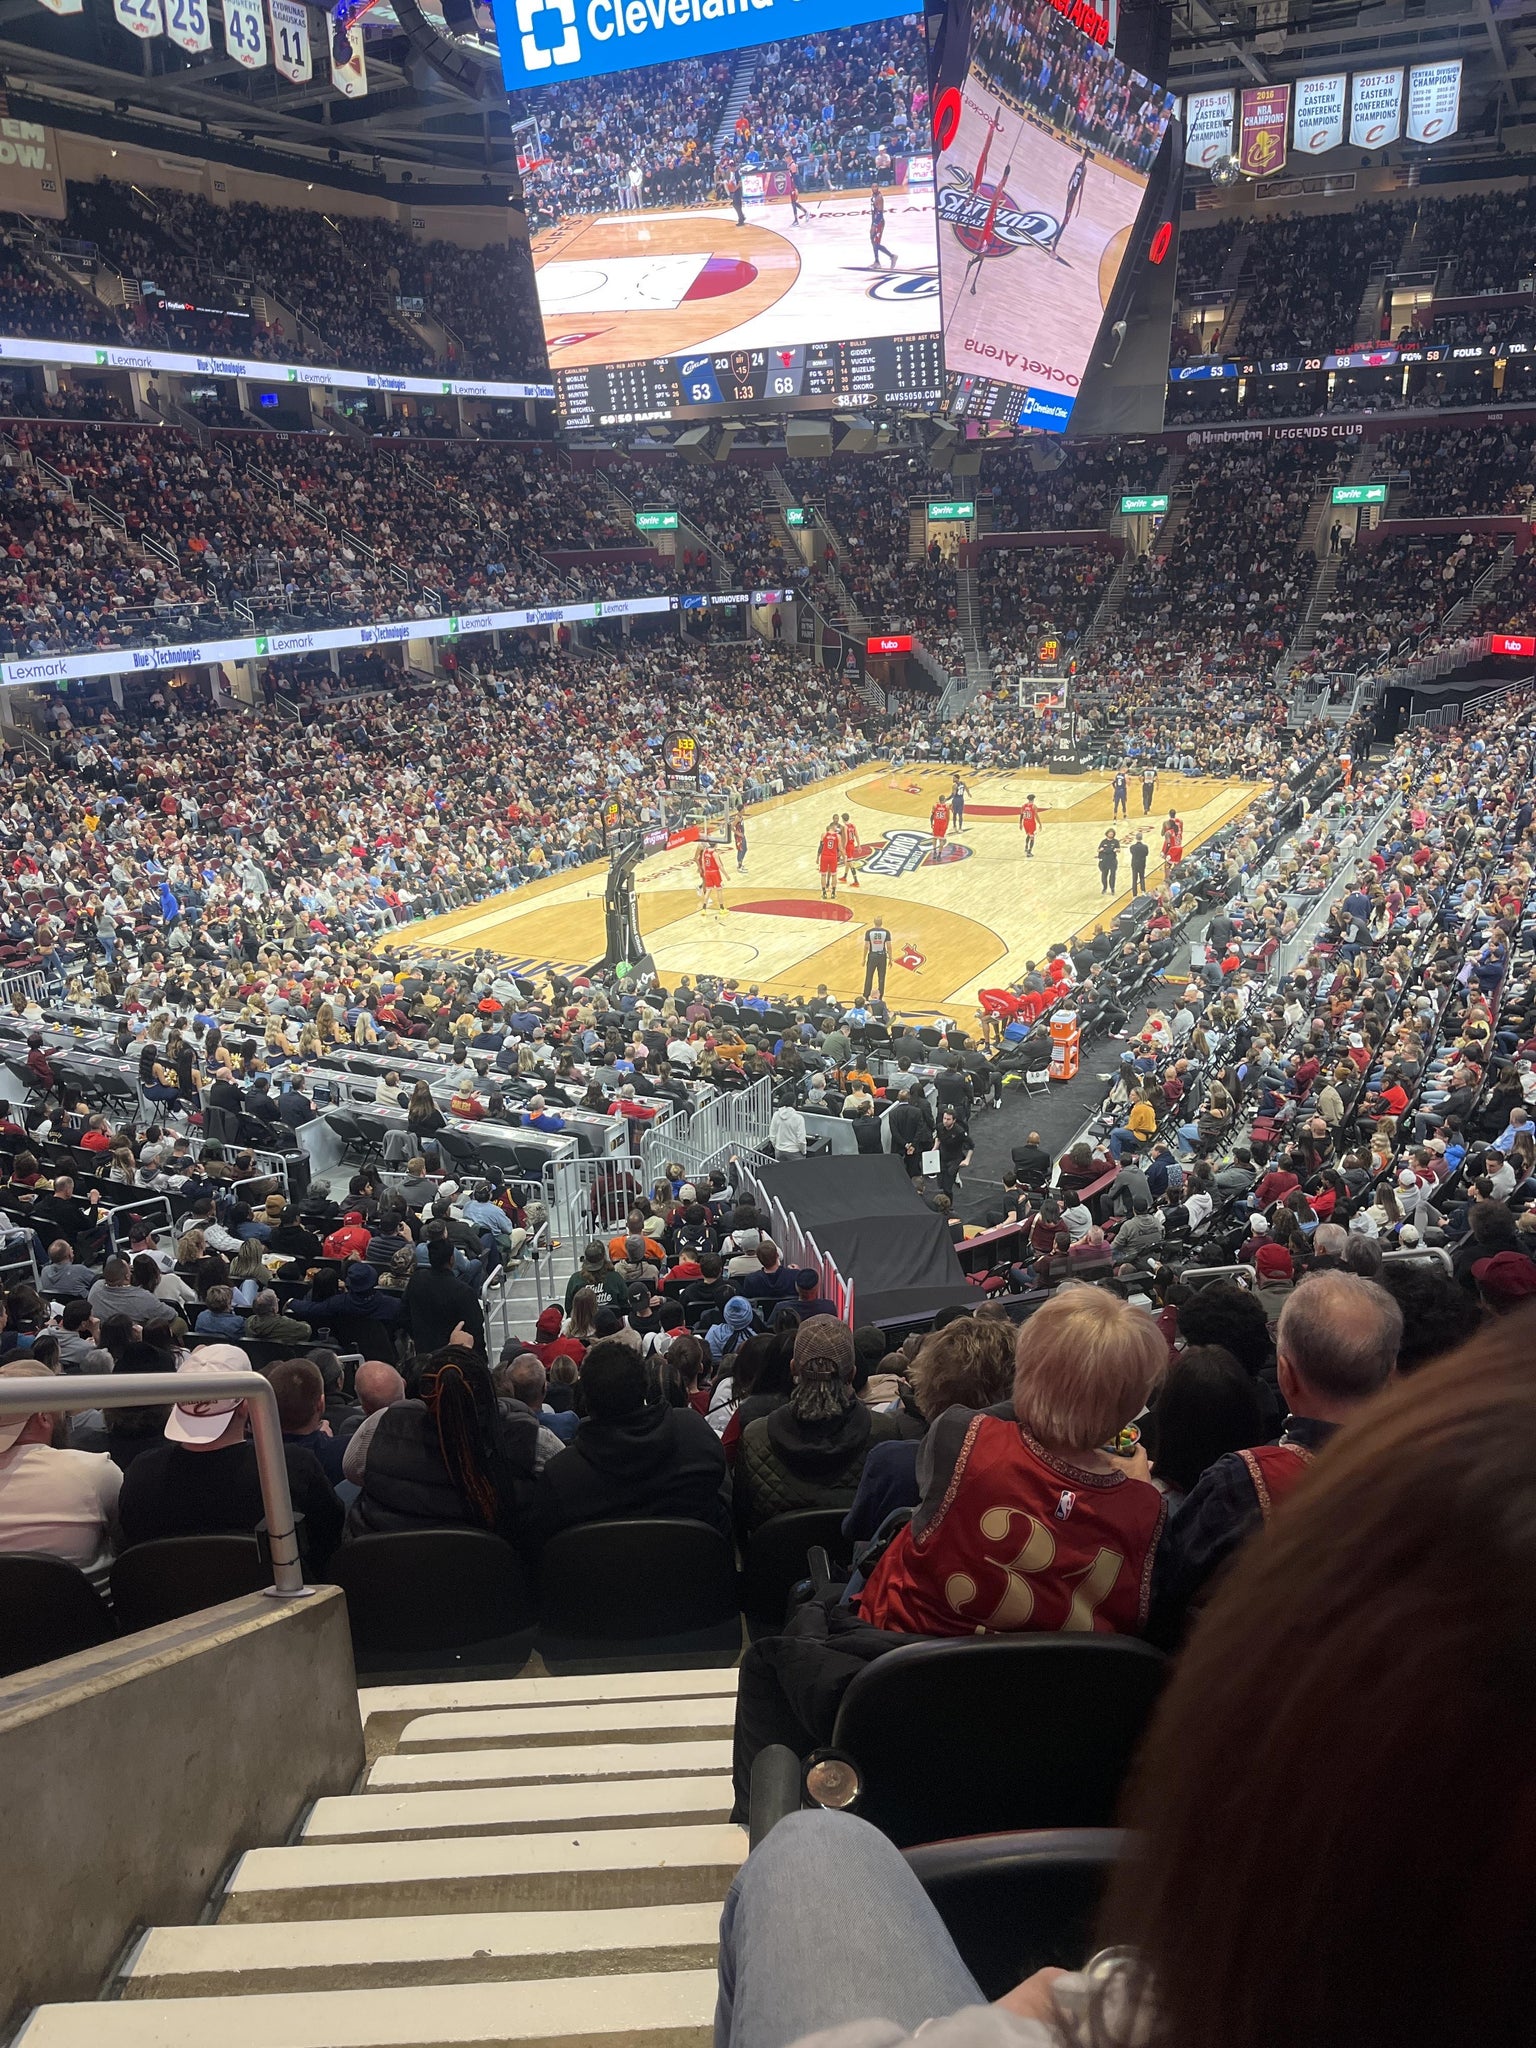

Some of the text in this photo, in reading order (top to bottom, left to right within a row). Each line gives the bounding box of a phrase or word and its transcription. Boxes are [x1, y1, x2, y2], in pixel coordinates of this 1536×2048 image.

[272, 0, 305, 18] ZYDRUNAS
[230, 10, 261, 52] 43
[280, 27, 305, 67] 11
[1412, 66, 1459, 79] CENTRAL DIVISION
[1304, 81, 1338, 93] 2016-17
[1360, 75, 1395, 88] 2017-18
[1413, 75, 1457, 87] CHAMPIONS
[1256, 91, 1274, 100] 2016
[1304, 94, 1336, 106] EASTERN
[1360, 88, 1393, 100] EASTERN
[1194, 96, 1227, 108] 2015-16
[1354, 98, 1399, 112] CONFERENCE
[1196, 110, 1225, 121] EASTERN
[1257, 104, 1272, 116] NBA
[1298, 104, 1341, 117] CONFERENCE
[1355, 109, 1396, 122] CHAMPIONS
[1244, 113, 1284, 126] CHAMPIONS
[1299, 115, 1339, 128] CHAMPIONS
[1190, 121, 1226, 132] CONFEREN
[1191, 130, 1229, 142] CHAMPIONS
[912, 161, 932, 173] drug
[715, 359, 728, 370] 2Q
[751, 352, 764, 366] 24
[851, 357, 876, 365] VUCEVIC
[1210, 366, 1224, 377] 53
[1243, 365, 1254, 374] 24
[1270, 362, 1289, 372] 1:33
[1304, 359, 1321, 370] 2Q
[1337, 356, 1350, 367] 68
[1401, 352, 1422, 362] FG%
[1426, 351, 1440, 361] 58
[1453, 348, 1482, 358] FOULS
[1489, 346, 1496, 355] 4
[1509, 344, 1527, 353] TOL
[112, 353, 534, 396] Lexmark Blue Technologies Lexmark Blue Technologies Lexmark Blue
[1020, 356, 1080, 387] ocket
[692, 383, 711, 400] 53
[774, 377, 793, 394] 68
[733, 386, 754, 399] 1:33
[885, 390, 941, 402] CAVS5050.COM
[838, 394, 869, 407] $8,412
[570, 406, 595, 414] MITCHELL
[1033, 402, 1055, 416] Cleveland
[635, 411, 672, 421] RAFFLE
[1274, 426, 1328, 440] LEGENDS
[1332, 424, 1363, 437] CLUB
[1335, 488, 1362, 501] Sprite
[1124, 498, 1148, 510] Sprite
[930, 504, 954, 518] Sprite
[638, 514, 660, 527] Sprite
[701, 592, 762, 606] 5 TURNOVERS 8
[8, 602, 629, 680] Lexmark Blue Technologies Lexmark Blue Technologies Lexmark Blue Technologies Lexmark
[881, 640, 898, 650] fubo
[1505, 640, 1522, 651] fubo
[1040, 648, 1056, 660] 24
[672, 748, 693, 767] 24
[827, 839, 834, 849] 9
